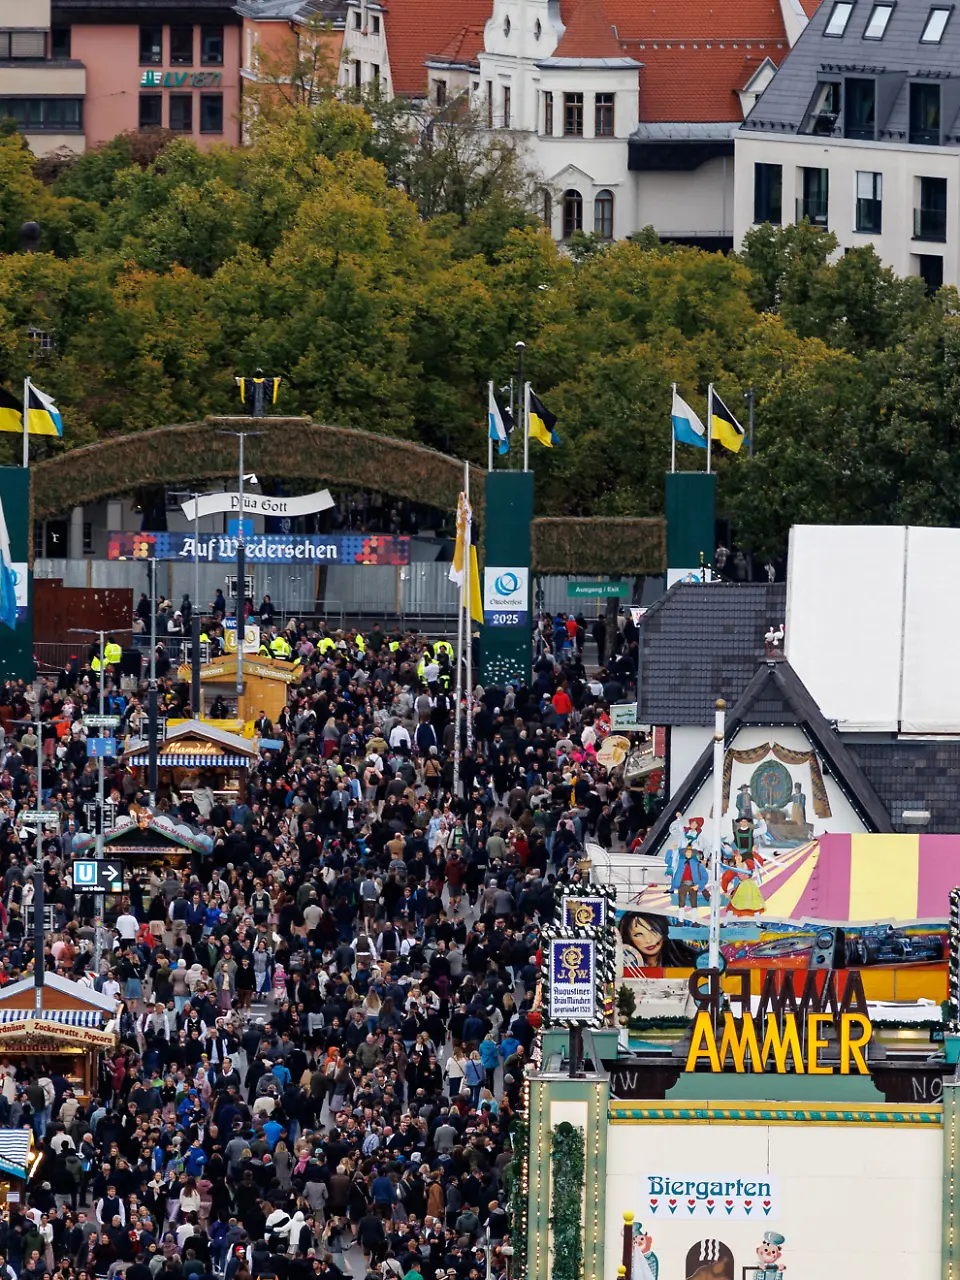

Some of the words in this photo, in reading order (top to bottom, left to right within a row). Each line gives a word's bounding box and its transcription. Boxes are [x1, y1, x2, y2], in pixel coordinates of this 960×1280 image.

[163, 71, 188, 87] LV
[190, 71, 222, 87] 1871
[261, 497, 288, 512] Gott
[178, 537, 216, 561] Auf
[218, 537, 338, 560] Wedersehen
[575, 586, 603, 595] Ausgang
[607, 585, 620, 593] Exit
[493, 613, 519, 625] 2025
[79, 864, 93, 882] U
[34, 1021, 79, 1038] Zuckerwatte
[83, 1031, 113, 1044] Popcorn
[684, 1010, 874, 1076] AMMER
[647, 1176, 772, 1201] Biergarten
